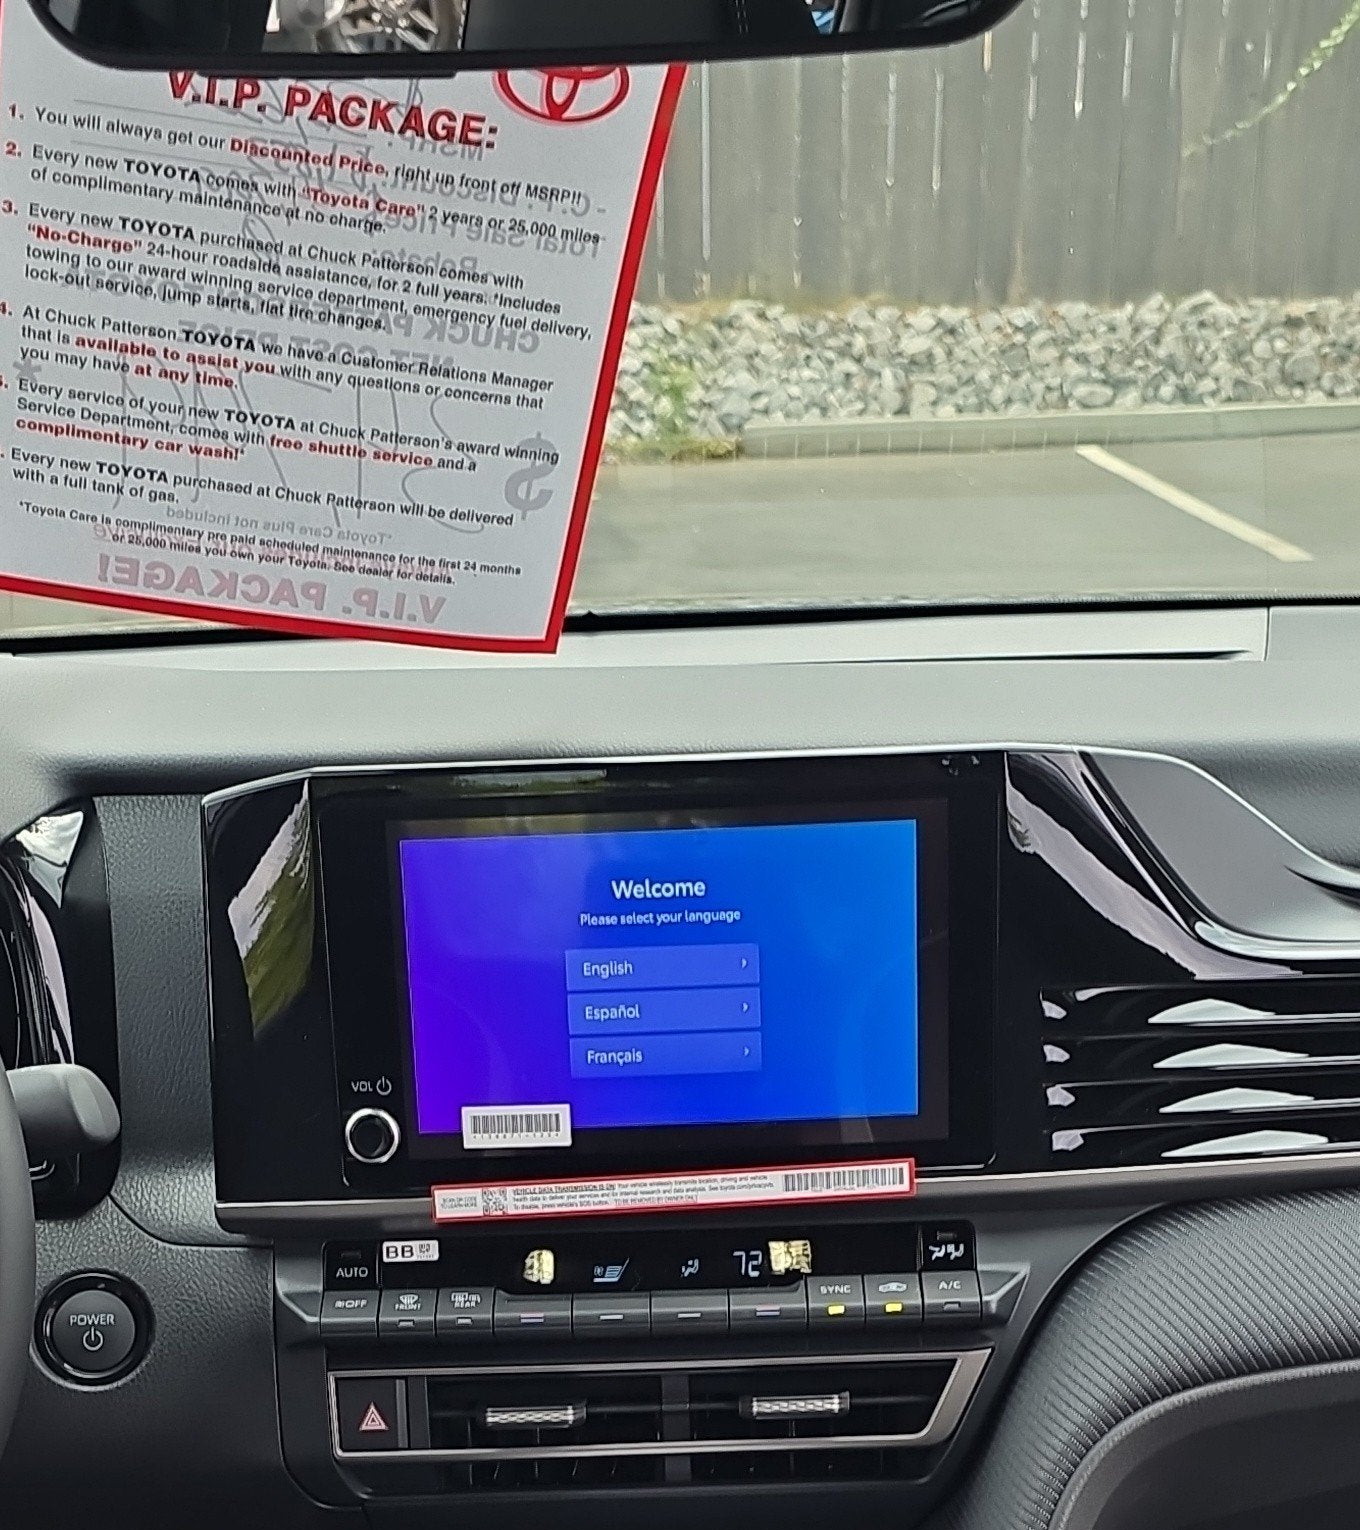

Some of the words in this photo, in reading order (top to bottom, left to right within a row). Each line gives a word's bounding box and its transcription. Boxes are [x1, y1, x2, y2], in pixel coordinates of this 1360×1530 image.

[168, 71, 267, 112] V.I.P.
[285, 86, 499, 149] PACKAGE:
[8, 103, 24, 119] 1.
[35, 107, 68, 125] You
[73, 114, 101, 130] will
[106, 119, 162, 141] always
[166, 130, 192, 145] get
[198, 135, 225, 150] our
[230, 137, 333, 167] Discounted
[338, 154, 388, 177] Price,
[394, 164, 430, 182] right
[435, 172, 454, 187] up
[459, 173, 494, 192] front
[500, 181, 520, 196] off
[526, 184, 580, 205] MSRP!!
[5, 141, 22, 156] 2.
[32, 144, 79, 168] Every
[84, 155, 118, 170] new
[124, 158, 200, 183] TOYOTA
[206, 174, 258, 192] comes
[264, 181, 296, 198] with
[428, 205, 438, 219] 2
[442, 210, 482, 226] years
[488, 217, 504, 229] or
[508, 218, 556, 237] 25,000
[560, 227, 600, 244] miles
[30, 166, 47, 181] of
[52, 172, 174, 205] complimentary
[179, 191, 284, 217] maintenance
[286, 206, 300, 220] at
[305, 211, 324, 223] no
[330, 213, 386, 235] charge.
[22, 305, 40, 319] At
[45, 308, 96, 327] Chuck
[101, 316, 176, 339] Patterson
[182, 329, 256, 350] TOYOTA
[262, 342, 282, 354] we
[288, 343, 324, 360] have
[327, 351, 336, 362] a
[341, 351, 412, 372] Customer
[418, 361, 486, 383] Relations
[490, 372, 554, 393] Manager
[20, 348, 50, 361] you
[54, 353, 86, 369] may
[92, 355, 130, 372] have
[134, 363, 151, 375] at
[157, 368, 188, 384] any
[195, 370, 238, 388] time.
[21, 325, 51, 342] that
[56, 330, 70, 345] is
[74, 335, 156, 357] available
[162, 345, 180, 360] to
[186, 352, 238, 368] assist
[244, 360, 276, 374] you
[280, 363, 311, 378] with
[315, 369, 342, 385] any
[347, 374, 420, 393] questions
[424, 384, 439, 395] or
[444, 387, 512, 405] concerns
[515, 394, 544, 410] that
[10, 447, 54, 469] Every
[60, 458, 91, 471] new
[96, 461, 168, 482] TOYOTA
[173, 475, 252, 494] purchased
[256, 484, 270, 496] at
[274, 485, 322, 503] Chuck
[326, 492, 396, 512] Patterson
[400, 502, 424, 516] will
[427, 504, 445, 518] be
[449, 507, 514, 526] delivered
[12, 467, 44, 482] with
[50, 474, 58, 484] a
[63, 474, 87, 489] full
[92, 478, 124, 494] tank
[128, 485, 144, 497] of
[148, 489, 178, 503] gas.
[611, 878, 706, 899] Welcome
[580, 912, 617, 926] Please
[620, 911, 654, 925] select
[656, 912, 682, 926] your
[685, 909, 741, 924] language
[583, 960, 633, 979] English
[585, 1004, 640, 1022] Español
[587, 1048, 643, 1067] Français
[351, 1080, 373, 1093] VOL
[385, 1245, 414, 1259] BB
[336, 1267, 369, 1278] AUTO
[733, 1250, 762, 1277] 72
[820, 1283, 851, 1294] SYNC
[938, 1280, 962, 1291] A/C
[69, 1313, 115, 1327] POWER
